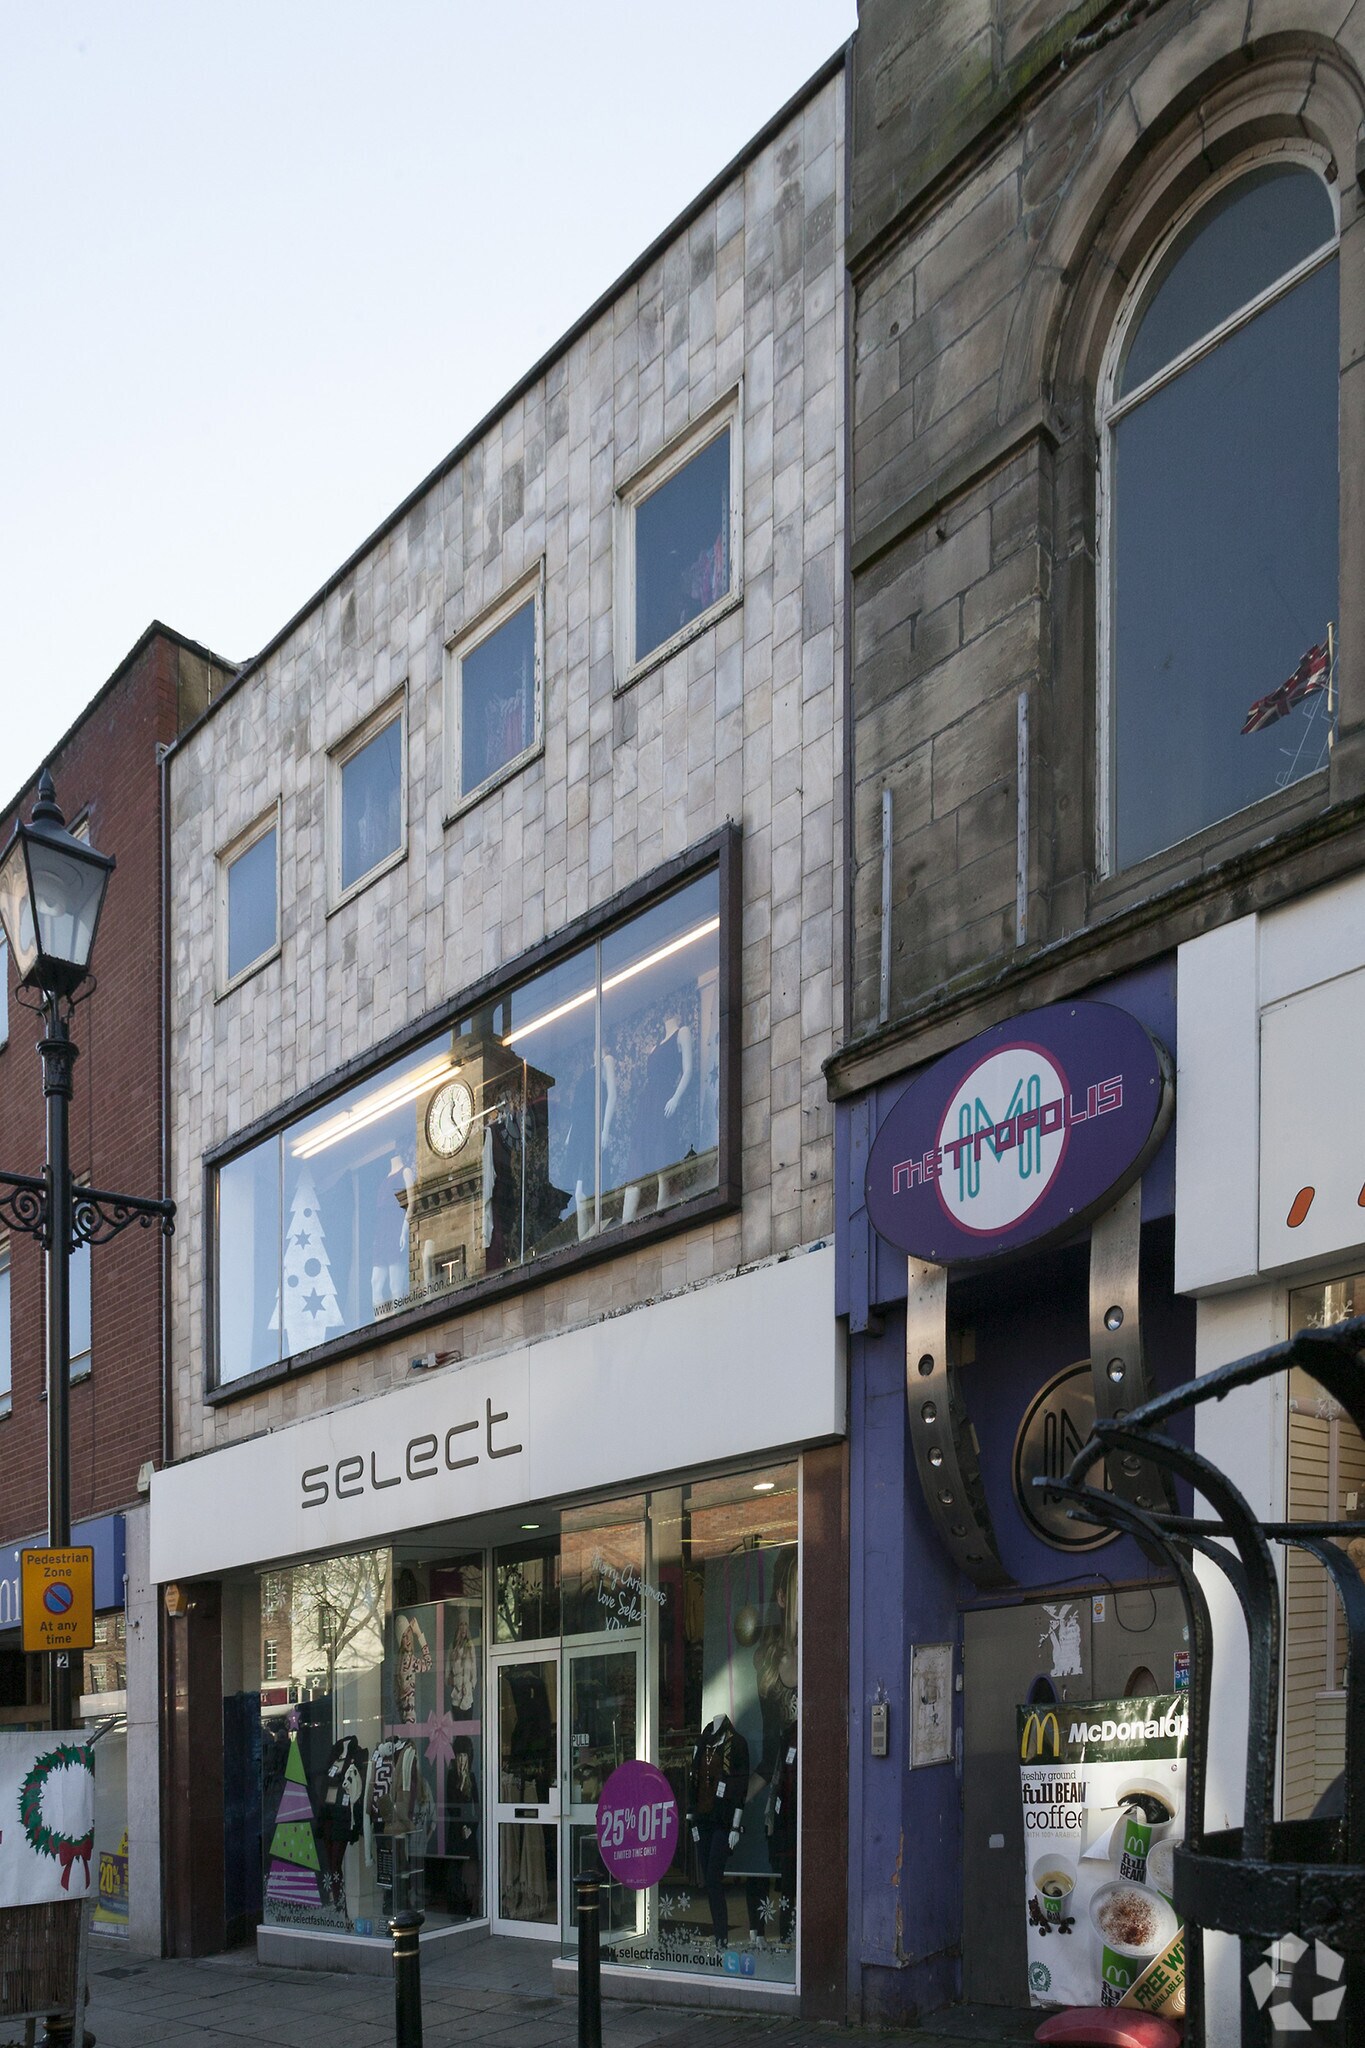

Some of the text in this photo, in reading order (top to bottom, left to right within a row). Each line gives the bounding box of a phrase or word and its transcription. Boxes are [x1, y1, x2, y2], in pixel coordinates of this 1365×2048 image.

[26, 1553, 89, 1565] Pedestrian
[44, 1567, 72, 1578] Zone
[597, 1580, 615, 1608] Love
[40, 1621, 78, 1632] At any
[46, 1634, 72, 1645] time
[1021, 1769, 1076, 1782] freshly ground
[601, 1801, 675, 1848] 25% OFF
[613, 1849, 632, 1860] LIMITED
[632, 1848, 643, 1858] TIME
[275, 1915, 355, 1933] www.selectfashion.co.uk
[1133, 1965, 1171, 2009] FREE
[1151, 1974, 1184, 2011] AVAILABLE
